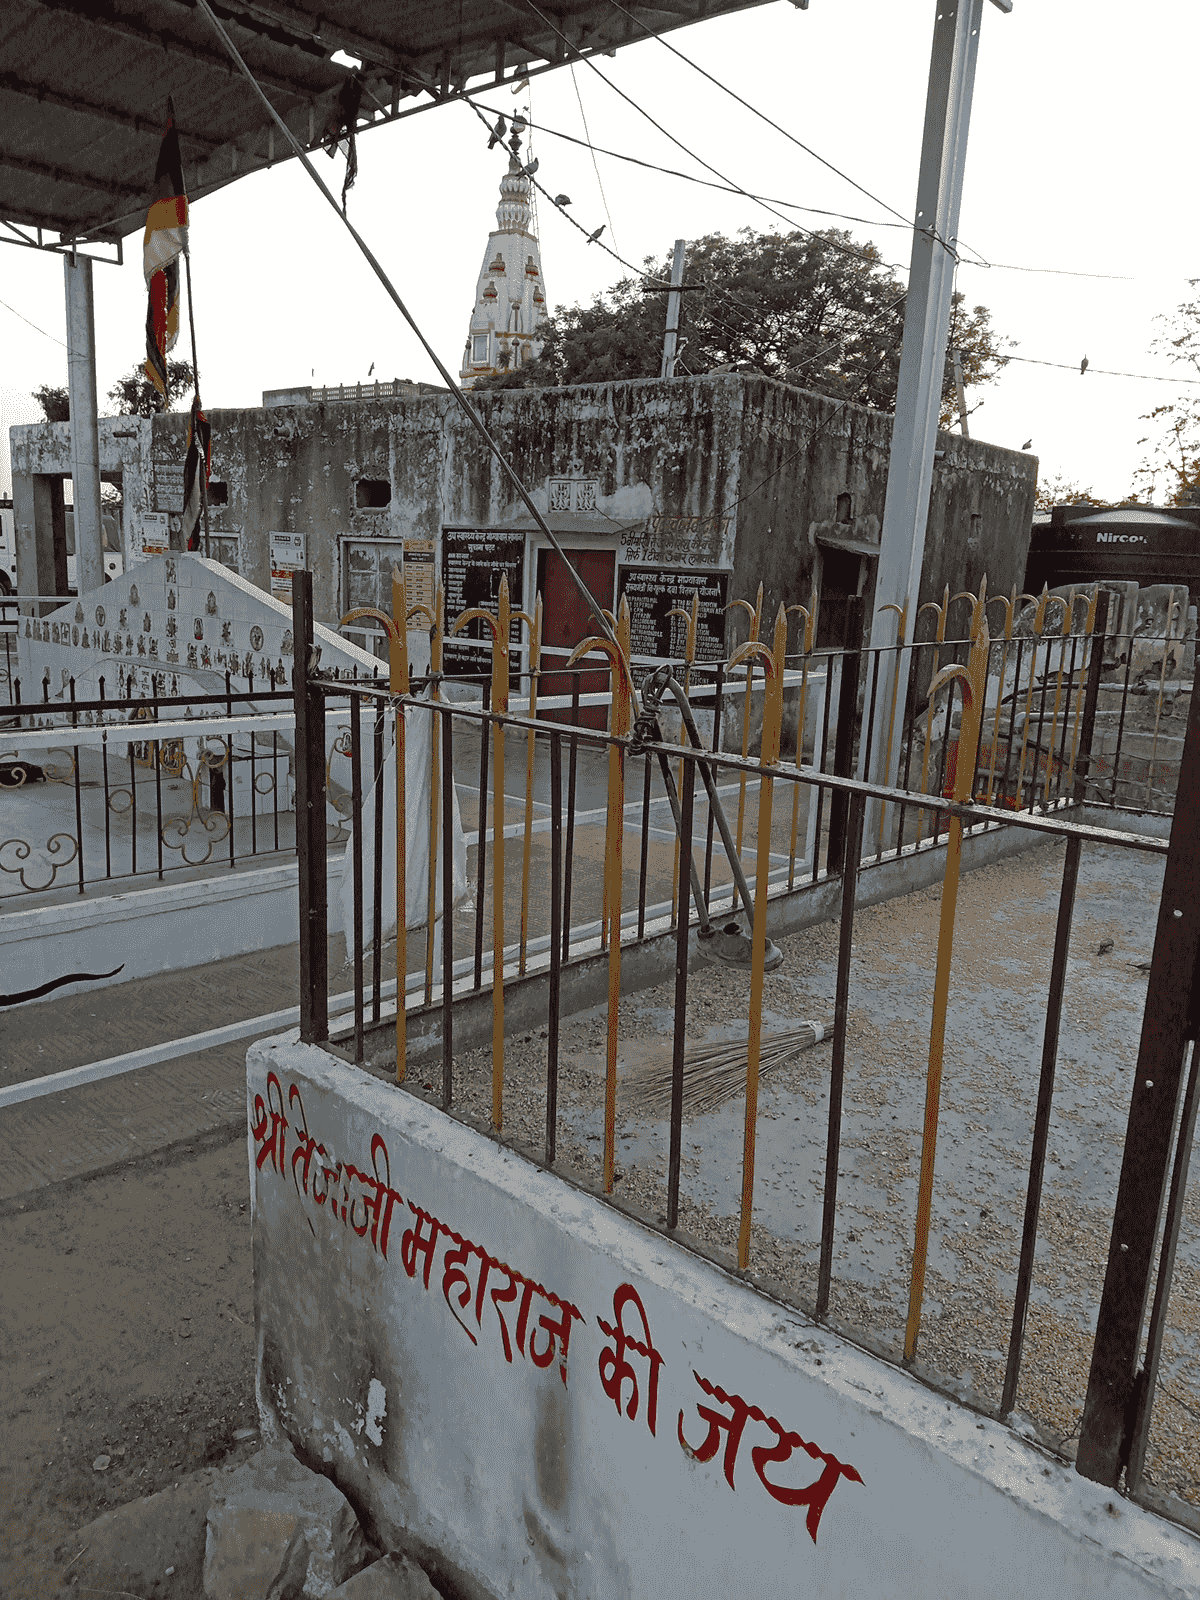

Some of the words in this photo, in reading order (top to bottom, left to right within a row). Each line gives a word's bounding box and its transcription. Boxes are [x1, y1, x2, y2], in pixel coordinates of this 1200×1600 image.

[659, 571, 676, 584] केन्द्र
[250, 1070, 290, 1181] श्री
[288, 1083, 404, 1263] तेजाजी
[400, 1197, 587, 1389] महाराज
[597, 1282, 666, 1437] की
[677, 1368, 867, 1545] जय
